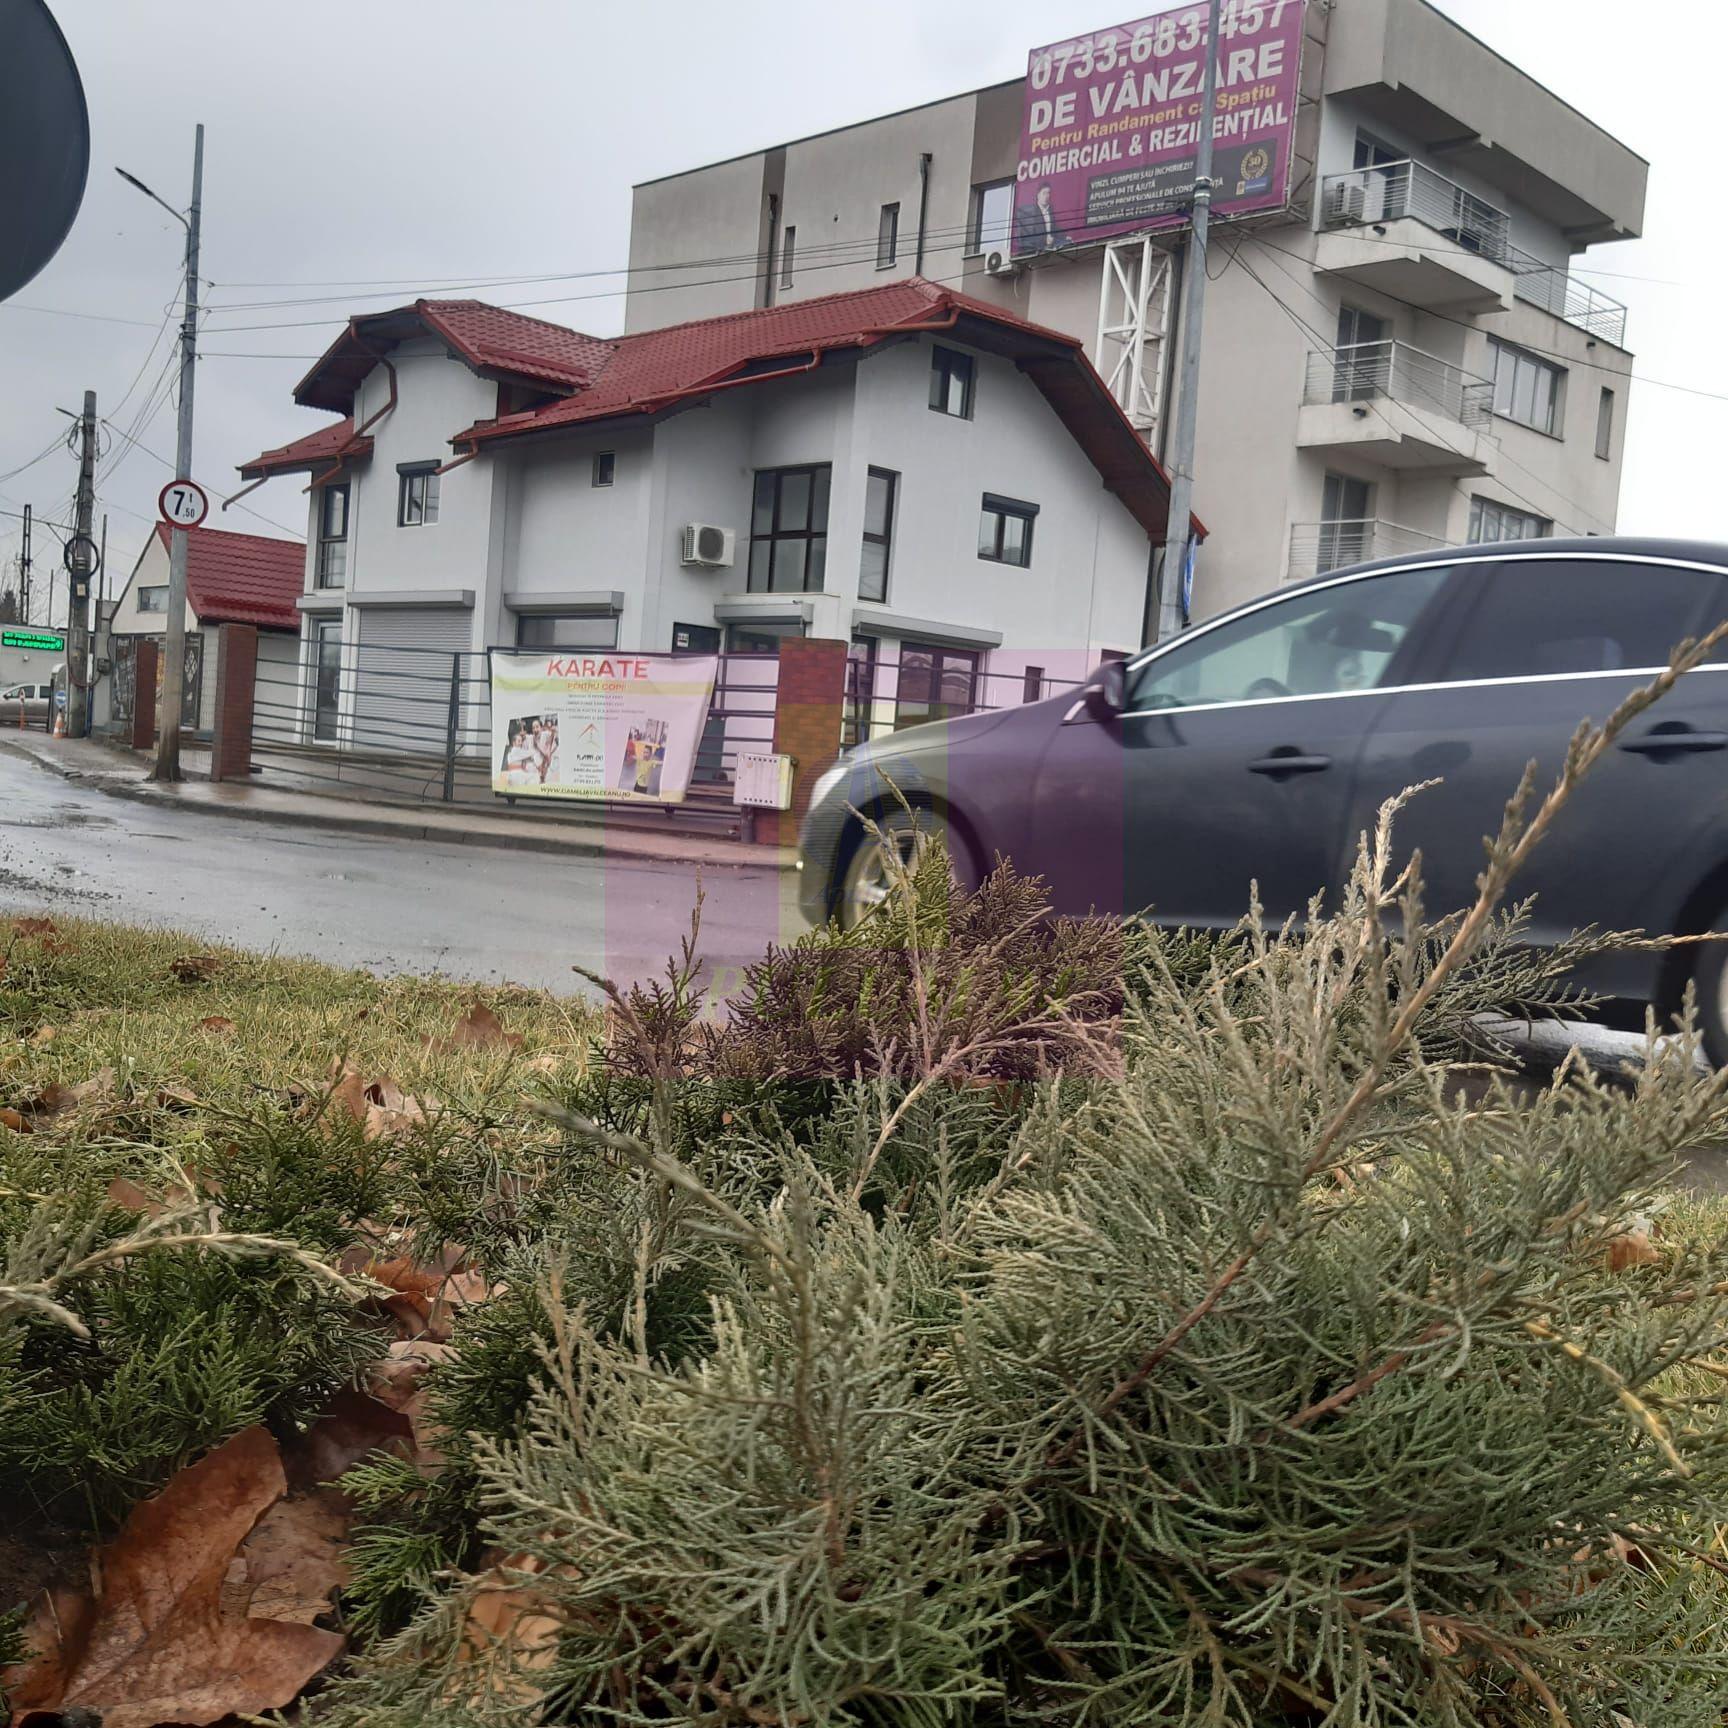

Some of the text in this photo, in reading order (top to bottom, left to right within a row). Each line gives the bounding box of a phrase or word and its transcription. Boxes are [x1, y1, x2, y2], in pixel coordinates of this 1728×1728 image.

[1032, 0, 1286, 90] 0733.683.457
[1029, 40, 1285, 135] DE VÂNZARE
[1032, 130, 1083, 153] Pentru
[1087, 104, 1184, 139] Randament
[1215, 85, 1277, 111] Spațiu
[1017, 139, 1122, 182] COMERCIAL
[1128, 134, 1143, 156] &
[1089, 189, 1116, 201] APULUM
[173, 490, 186, 515] 7
[547, 659, 650, 679] KARATE
